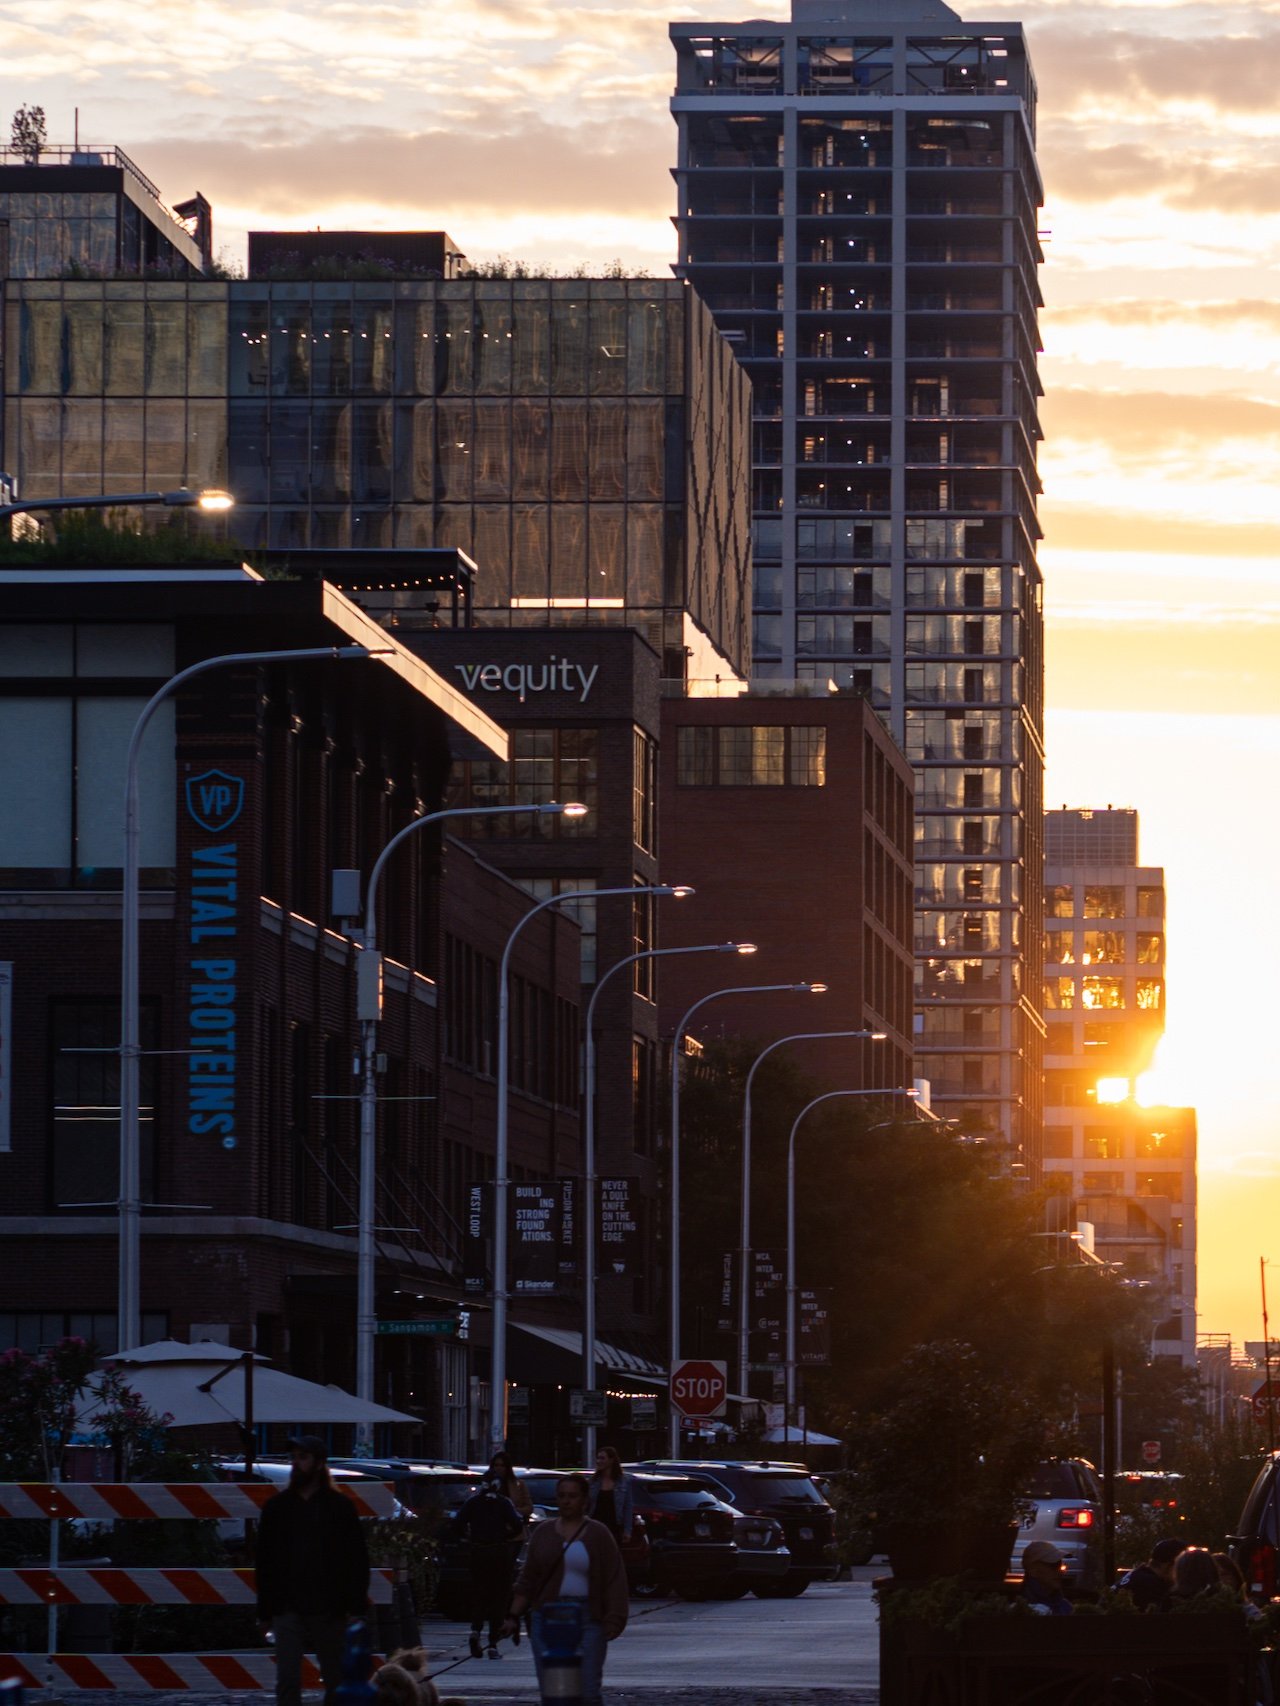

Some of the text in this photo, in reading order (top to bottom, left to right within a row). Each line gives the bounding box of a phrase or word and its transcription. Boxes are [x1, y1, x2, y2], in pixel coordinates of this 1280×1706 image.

[454, 655, 599, 702] vequity
[200, 785, 231, 816] VP
[190, 842, 238, 944] VITAL
[602, 1180, 628, 1190] NEVER
[516, 1187, 542, 1198] BUILD
[602, 1191, 630, 1200] A DULL
[539, 1198, 555, 1209] ING
[602, 1201, 625, 1211] KNIFE
[470, 1186, 482, 1239] WEST LOOP
[516, 1209, 550, 1220] STRONG
[562, 1180, 573, 1246] FULTON MARKET
[602, 1211, 630, 1221] ON THE
[516, 1220, 545, 1231] FOUND
[602, 1221, 637, 1231] CUTTING
[521, 1231, 555, 1242] ATIONS.
[602, 1231, 625, 1243] EDGE.
[675, 1378, 723, 1399] STOP
